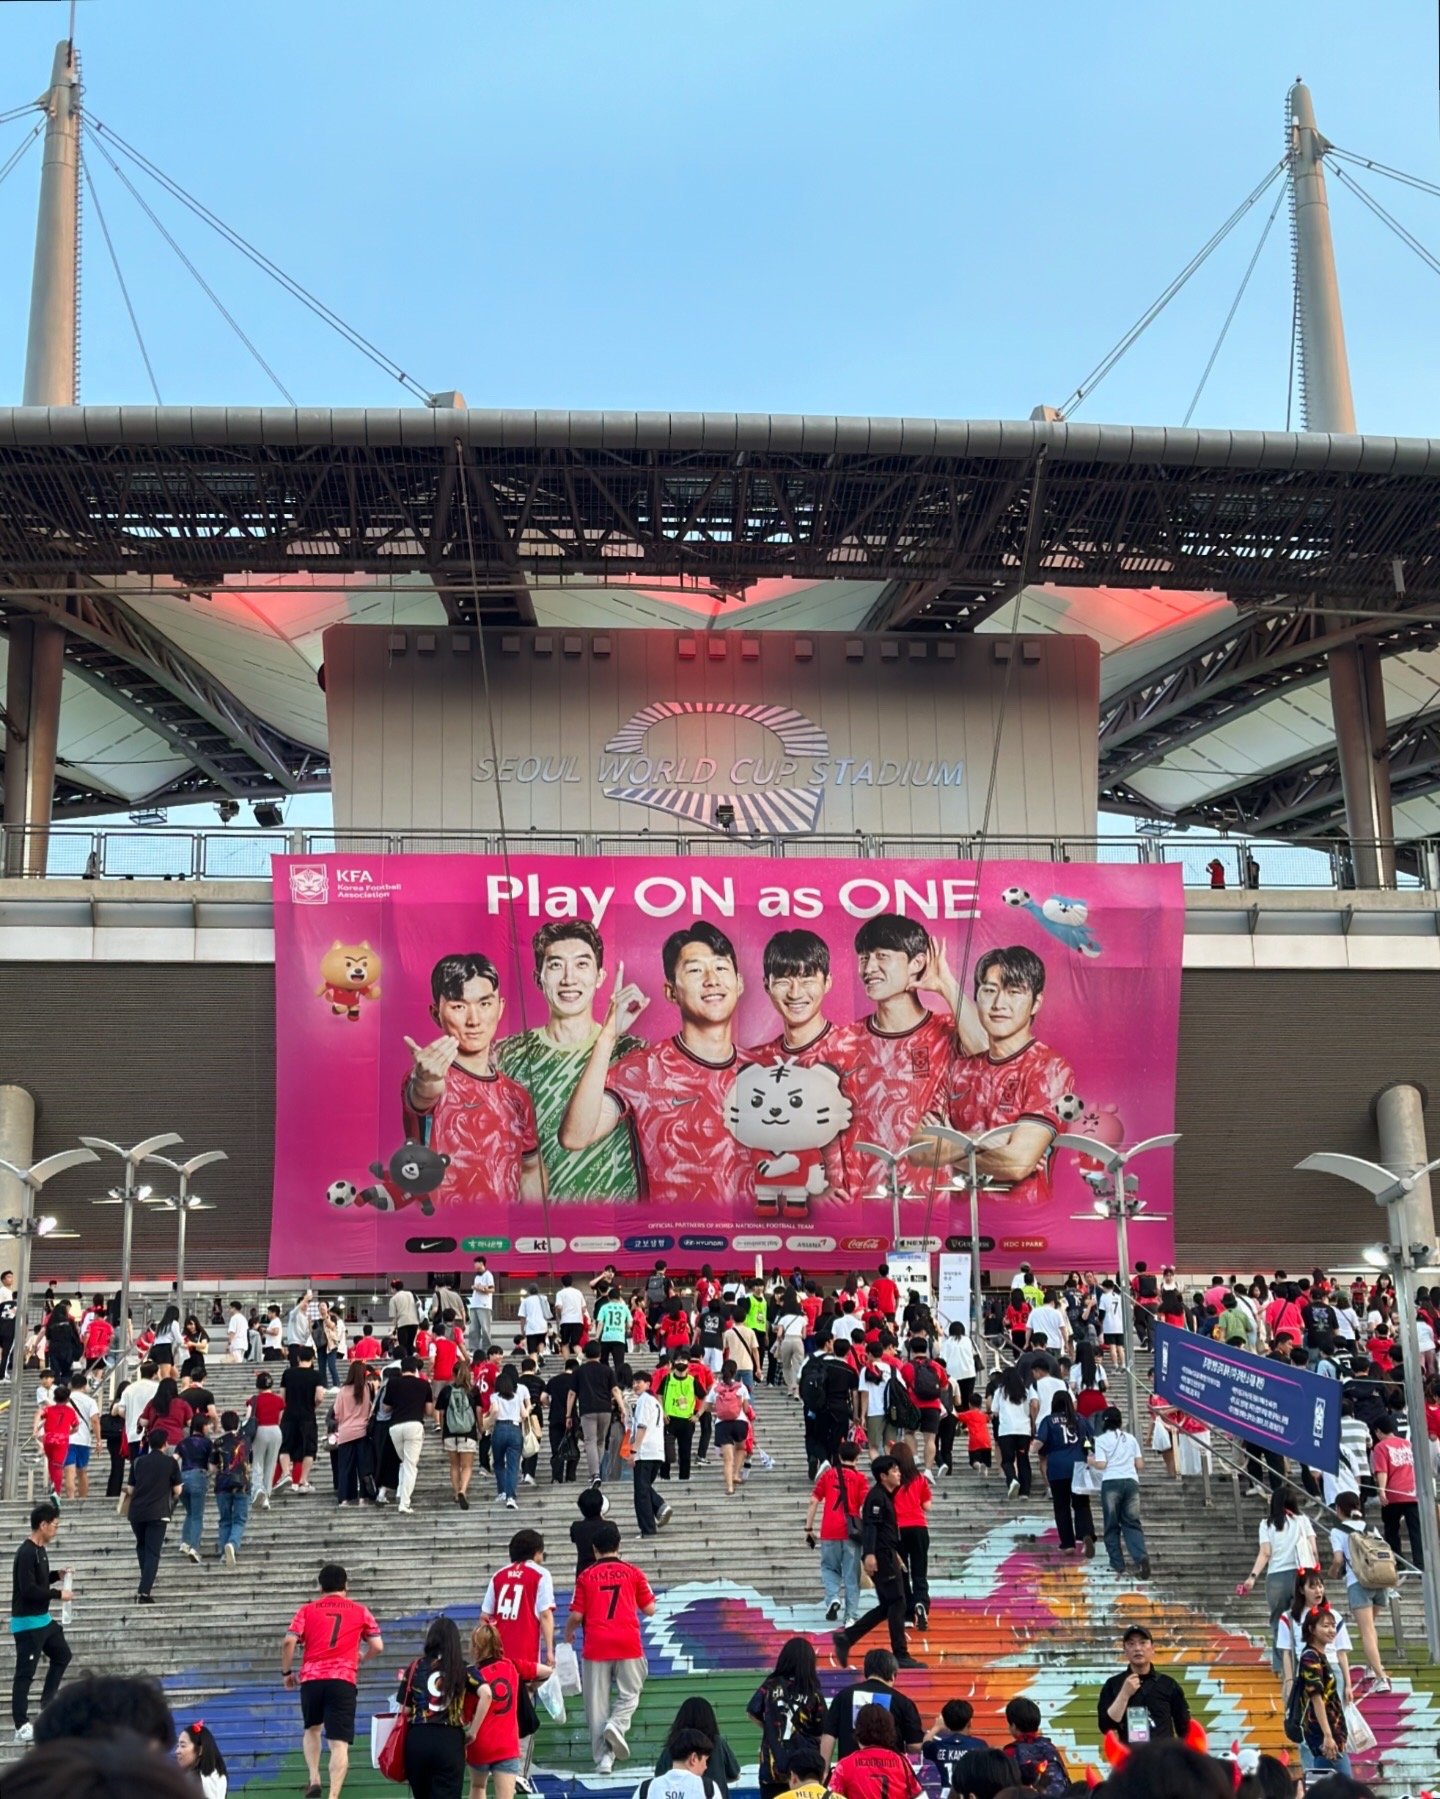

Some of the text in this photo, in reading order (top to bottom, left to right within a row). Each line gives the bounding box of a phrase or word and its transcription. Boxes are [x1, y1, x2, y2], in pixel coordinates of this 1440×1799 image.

[473, 755, 965, 788] SEOUL WORLD CUP STADIUM
[336, 869, 374, 883] KFA
[486, 873, 981, 928] Play ON as ONE
[533, 1240, 547, 1251] kt
[608, 1310, 622, 1326] 13
[1111, 1301, 1119, 1315] 7
[497, 1583, 523, 1620] 41
[600, 1583, 621, 1621] 7
[325, 1612, 343, 1649] 7
[490, 1677, 513, 1715] 9
[869, 1773, 890, 1799] 7
